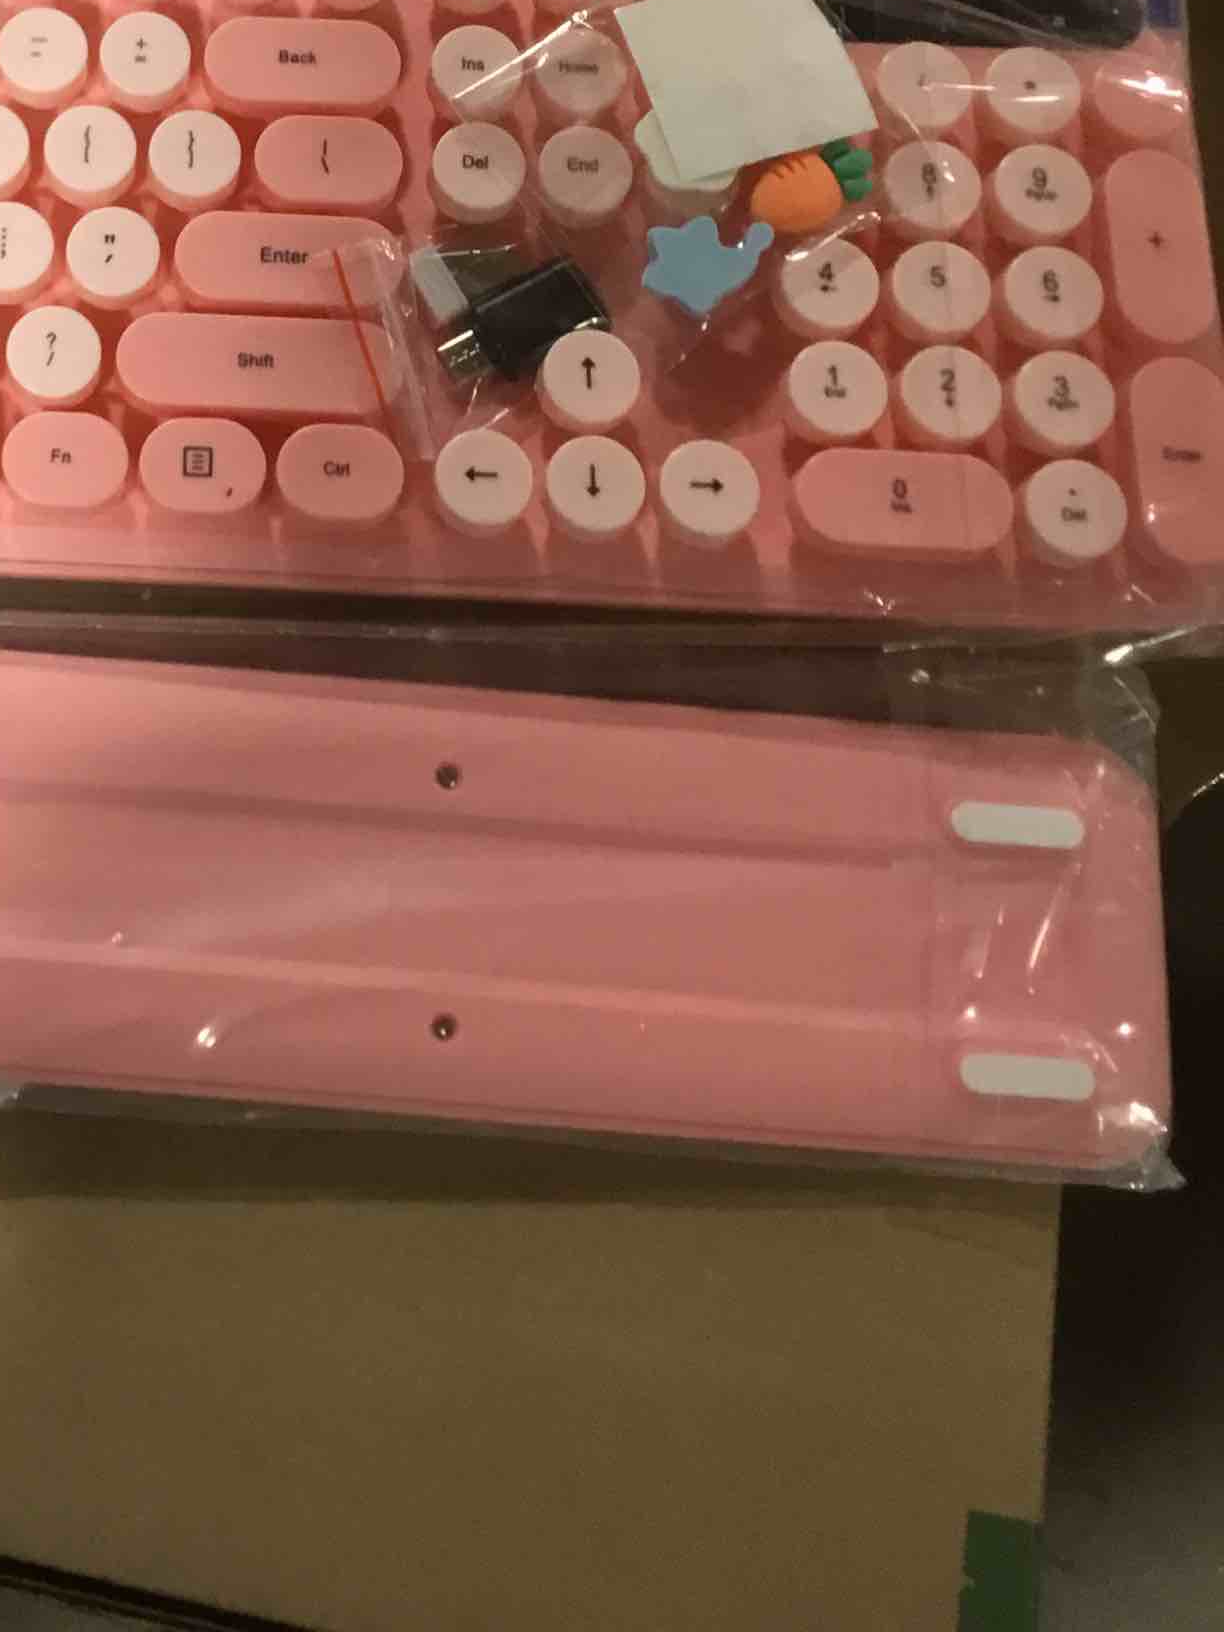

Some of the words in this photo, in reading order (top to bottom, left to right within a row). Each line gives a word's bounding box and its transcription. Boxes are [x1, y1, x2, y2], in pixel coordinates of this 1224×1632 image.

[278, 50, 317, 64] Back
[260, 246, 309, 264] Enter
[930, 266, 946, 287] 5
[1043, 271, 1059, 292] 6
[238, 352, 274, 368] Shift
[941, 370, 955, 392] 2
[1053, 376, 1070, 398] 3
[50, 448, 71, 464] Fn
[323, 461, 350, 476] Ctrl
[893, 479, 907, 499] 0
